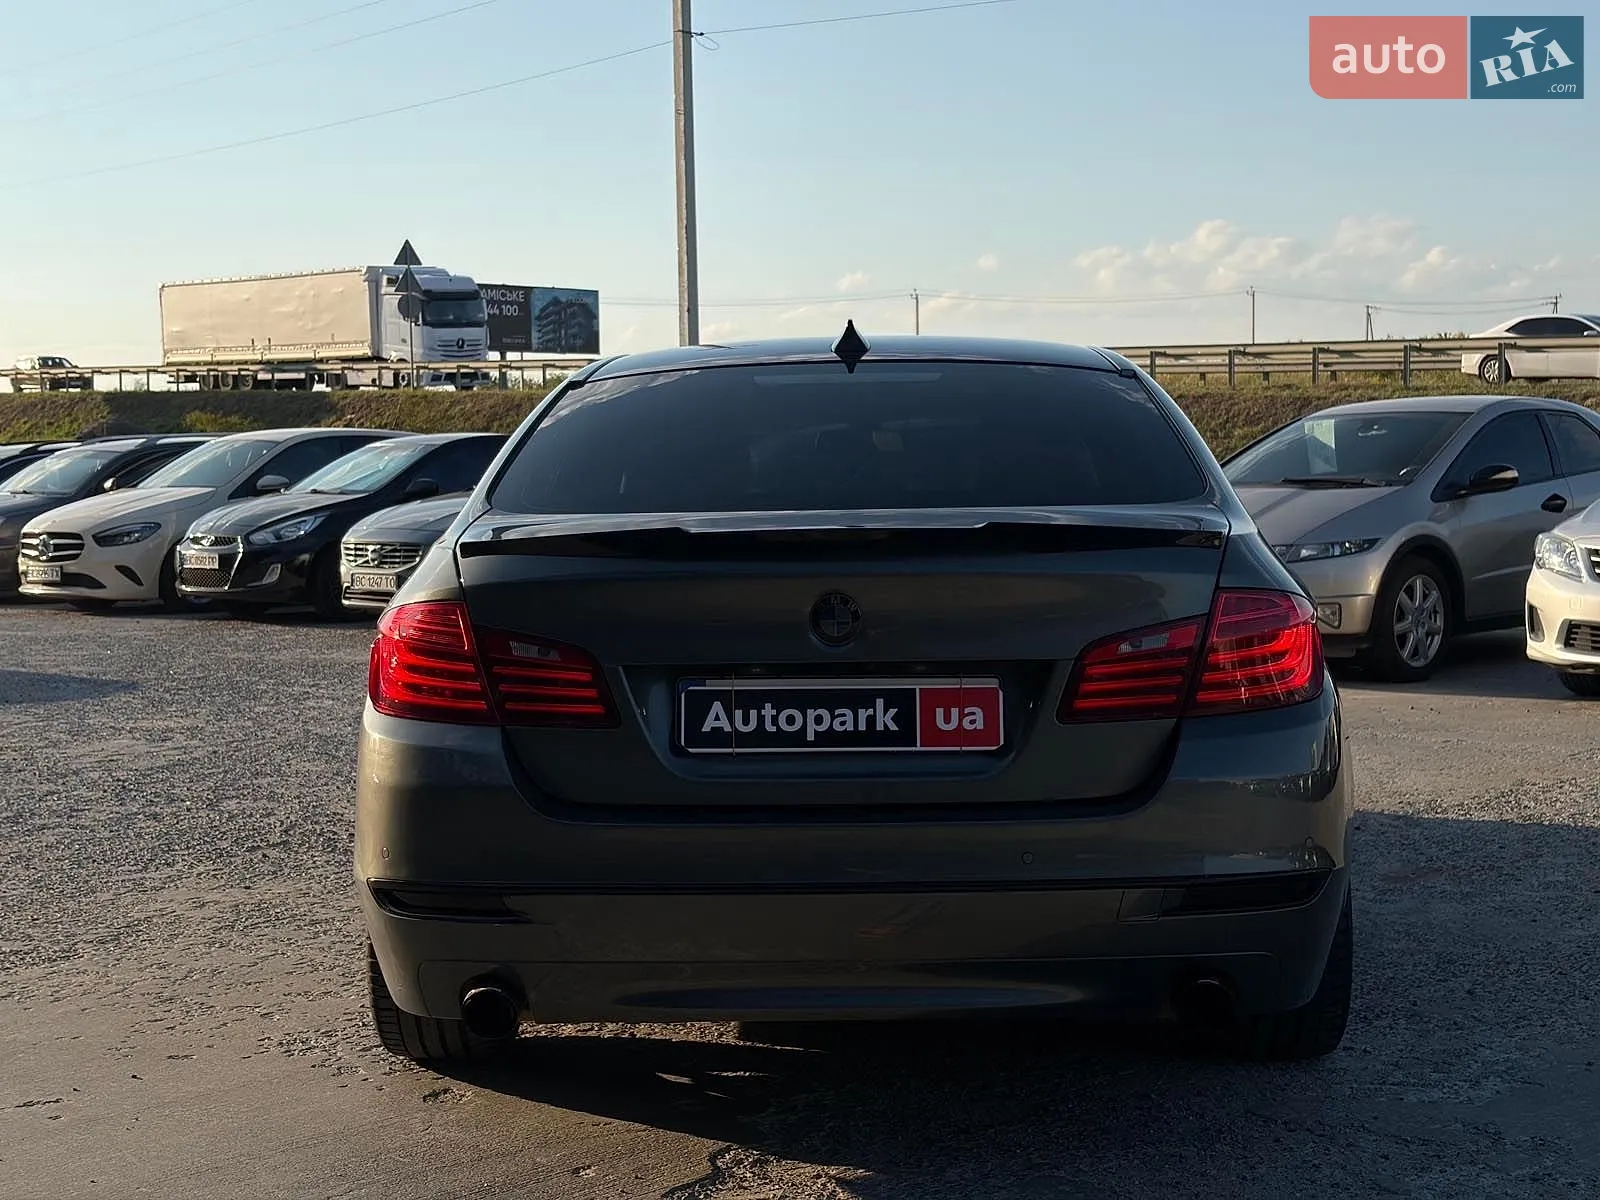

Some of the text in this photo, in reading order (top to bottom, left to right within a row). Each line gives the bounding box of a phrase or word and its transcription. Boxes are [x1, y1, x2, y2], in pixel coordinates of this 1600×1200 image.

[501, 304, 519, 316] 100
[355, 575, 395, 588] BC 1247 TO
[701, 698, 984, 741] Autopark ua
